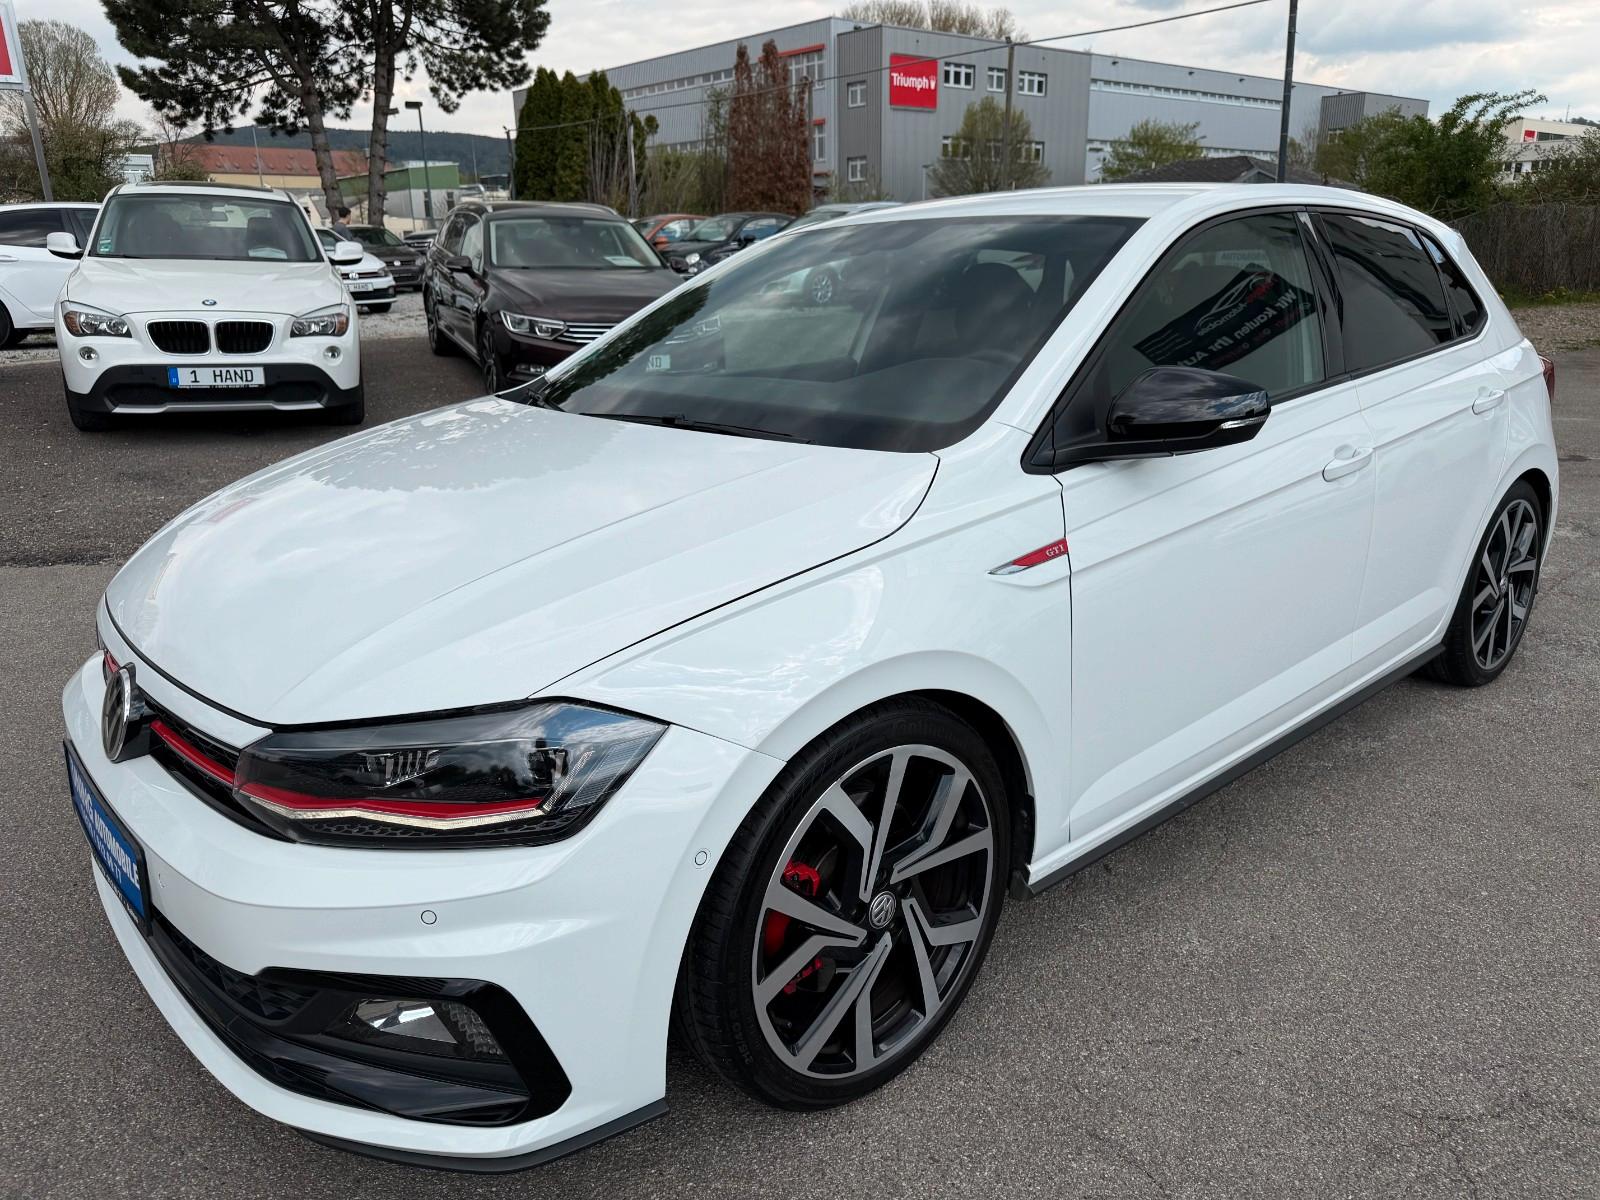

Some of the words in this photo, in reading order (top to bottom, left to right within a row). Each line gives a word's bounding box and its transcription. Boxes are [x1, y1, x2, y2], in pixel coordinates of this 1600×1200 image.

[891, 73, 929, 92] Triumph
[190, 370, 200, 383] 1
[213, 369, 254, 383] HAND
[1045, 543, 1065, 557] GTI
